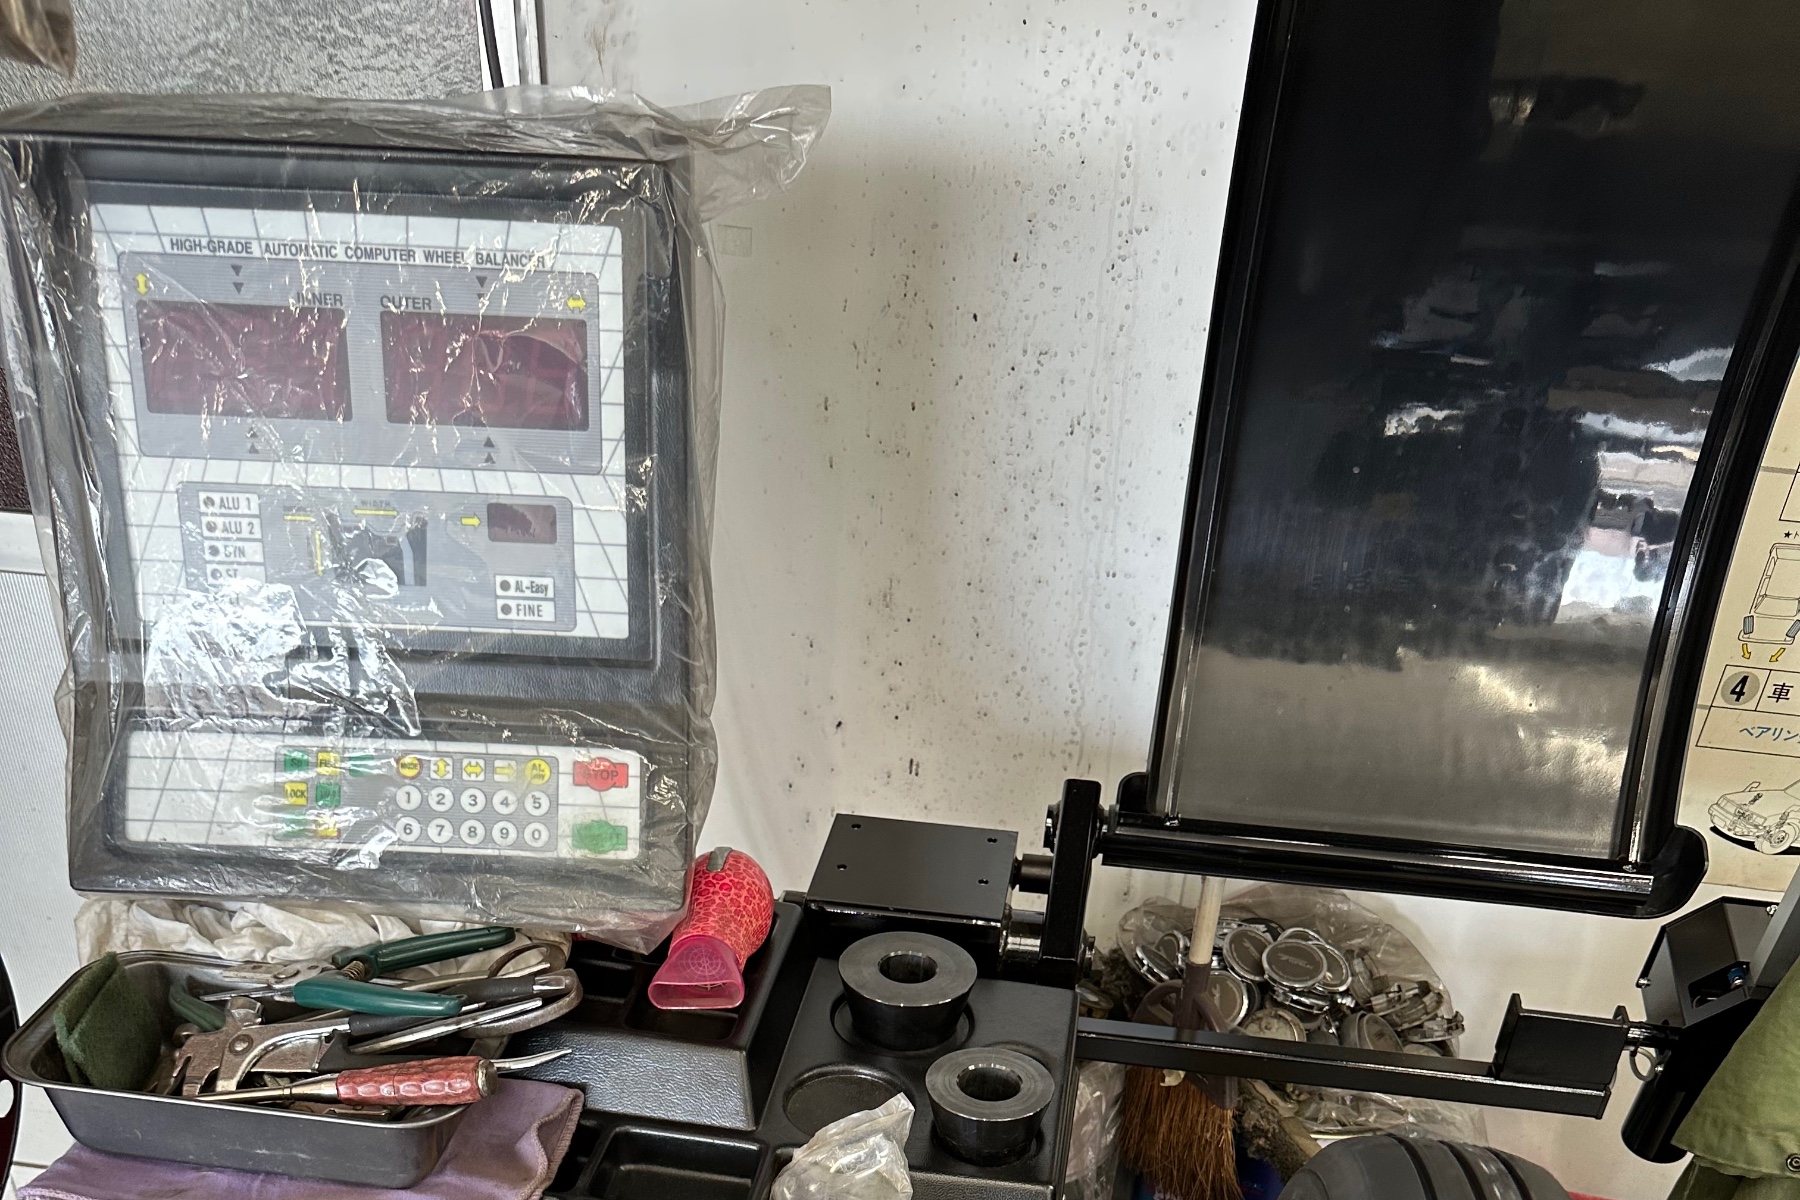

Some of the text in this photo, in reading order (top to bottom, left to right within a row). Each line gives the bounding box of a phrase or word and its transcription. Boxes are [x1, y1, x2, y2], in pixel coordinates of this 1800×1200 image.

[169, 237, 254, 255] HIGH-GRADE
[264, 241, 338, 259] AUTOMATIC
[344, 244, 416, 263] COMPUTER
[296, 291, 343, 307] INNER
[379, 294, 432, 311] OUTER
[219, 496, 252, 511] ALU 1
[221, 521, 255, 535] ALU 2
[514, 579, 549, 597] AL-Easy
[516, 603, 543, 618] FINE
[1730, 675, 1794, 703] 4 車
[583, 768, 619, 781] STOP
[285, 788, 307, 799] LOCK
[404, 792, 541, 809] 1 2 3 4 5
[403, 824, 541, 841] 6 7 8 9 0
